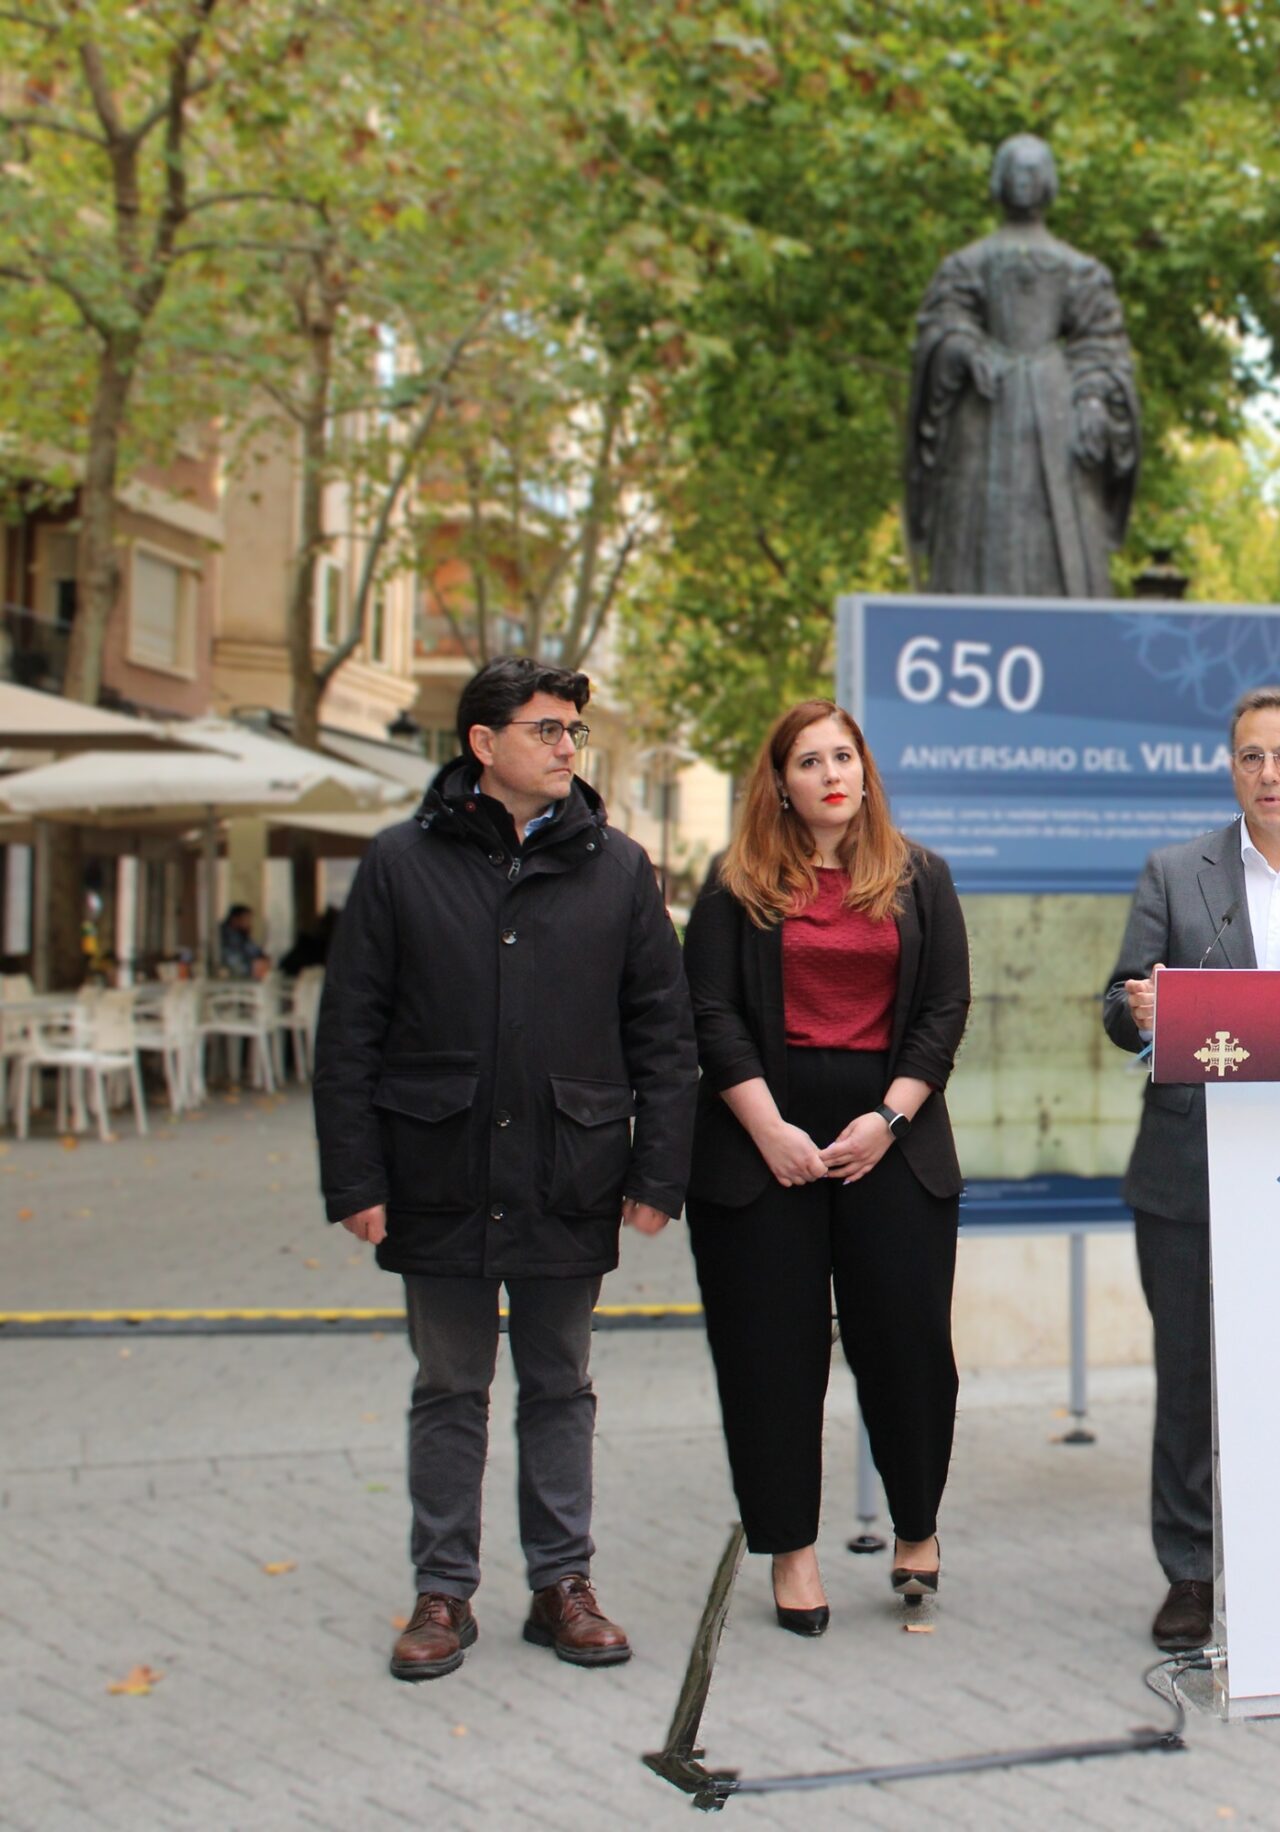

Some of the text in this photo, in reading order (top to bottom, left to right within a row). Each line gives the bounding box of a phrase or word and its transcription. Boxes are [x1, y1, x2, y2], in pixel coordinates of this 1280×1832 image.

[896, 636, 1043, 713] 650
[900, 742, 1231, 773] ANIVERSARIO DEL VILLA
